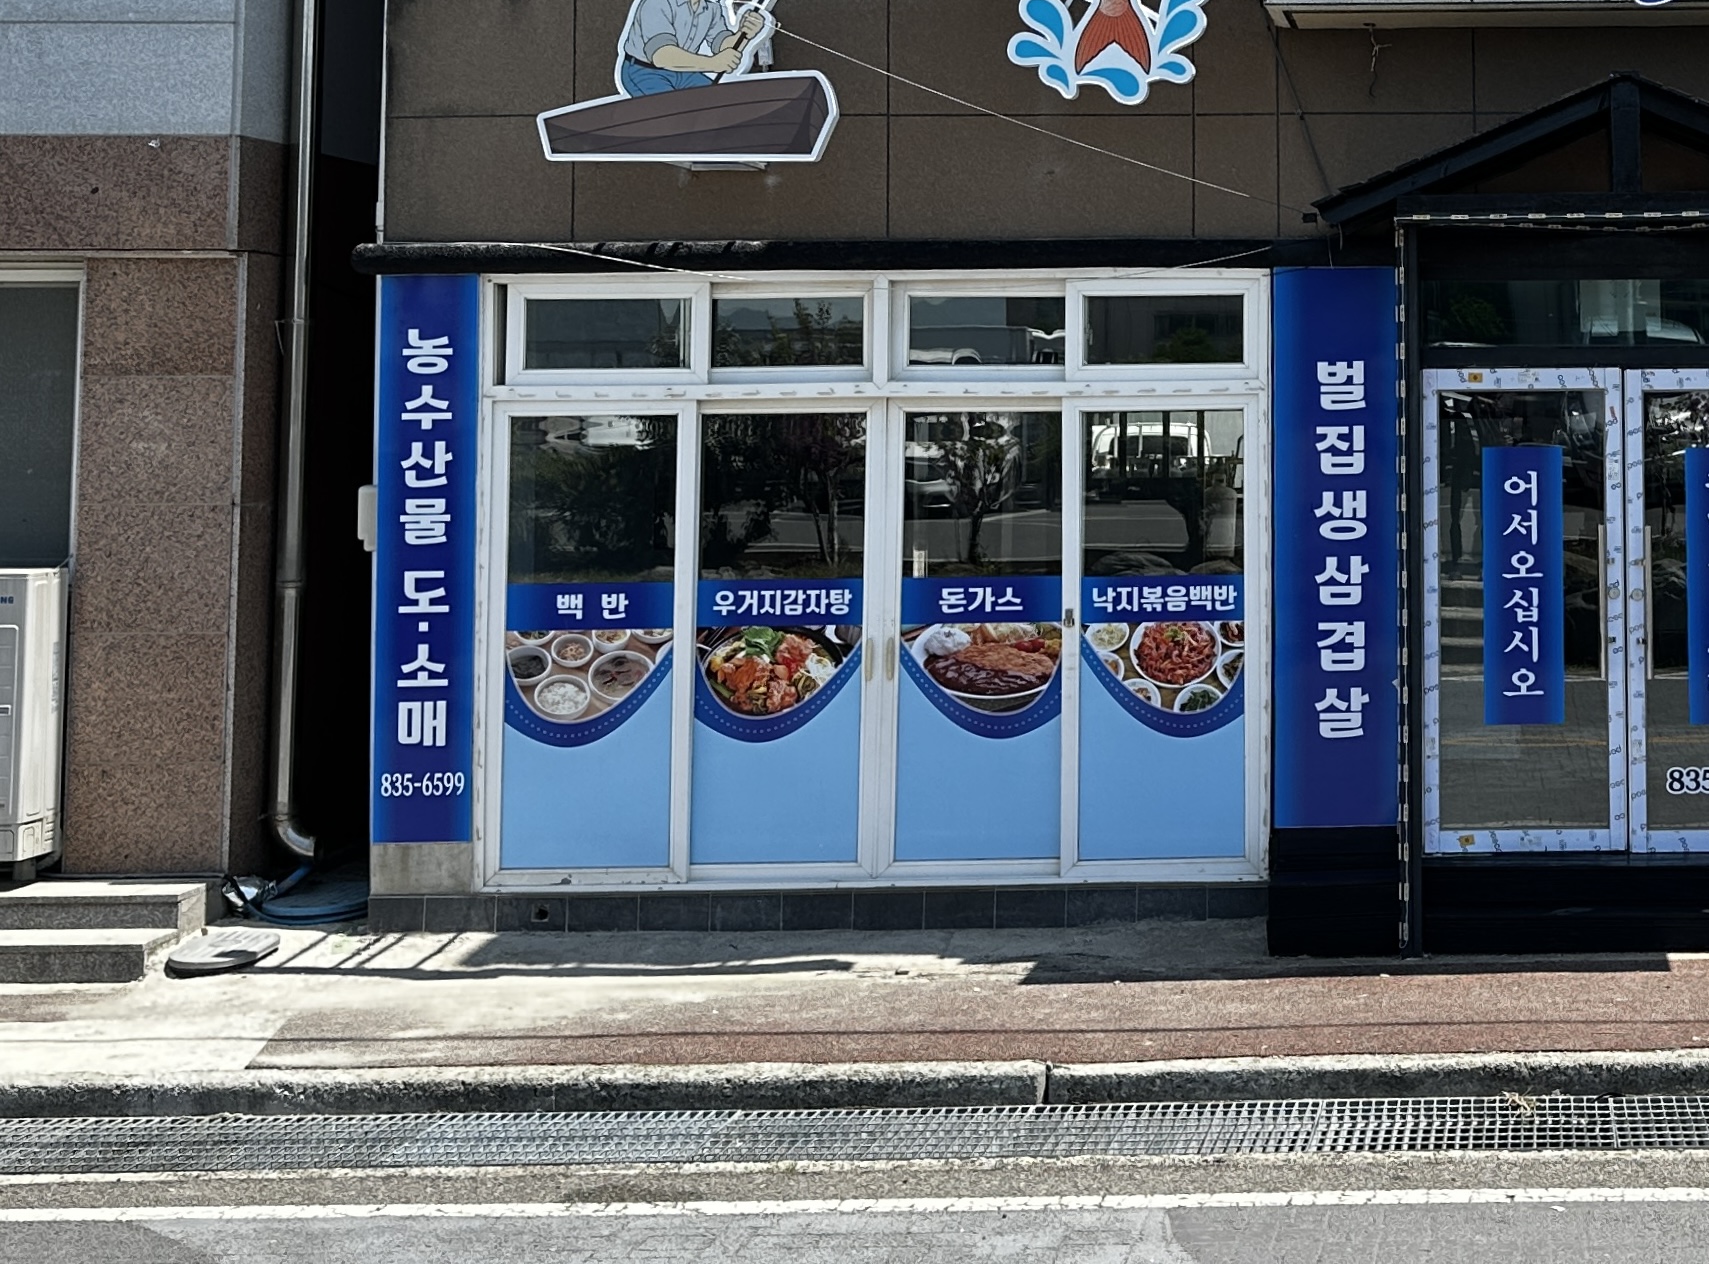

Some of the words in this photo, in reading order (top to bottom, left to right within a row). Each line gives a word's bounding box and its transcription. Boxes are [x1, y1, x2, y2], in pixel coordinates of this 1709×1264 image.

[399, 328, 454, 546] 농수산물
[1313, 360, 1370, 739] 벌집생삼겹살
[1502, 470, 1544, 697] 어서오십시오
[712, 589, 854, 616] 우거지감자탕
[938, 587, 1023, 613] 돈가스
[1092, 585, 1238, 612] 낙지볶음백반
[380, 771, 466, 798] 835-6599
